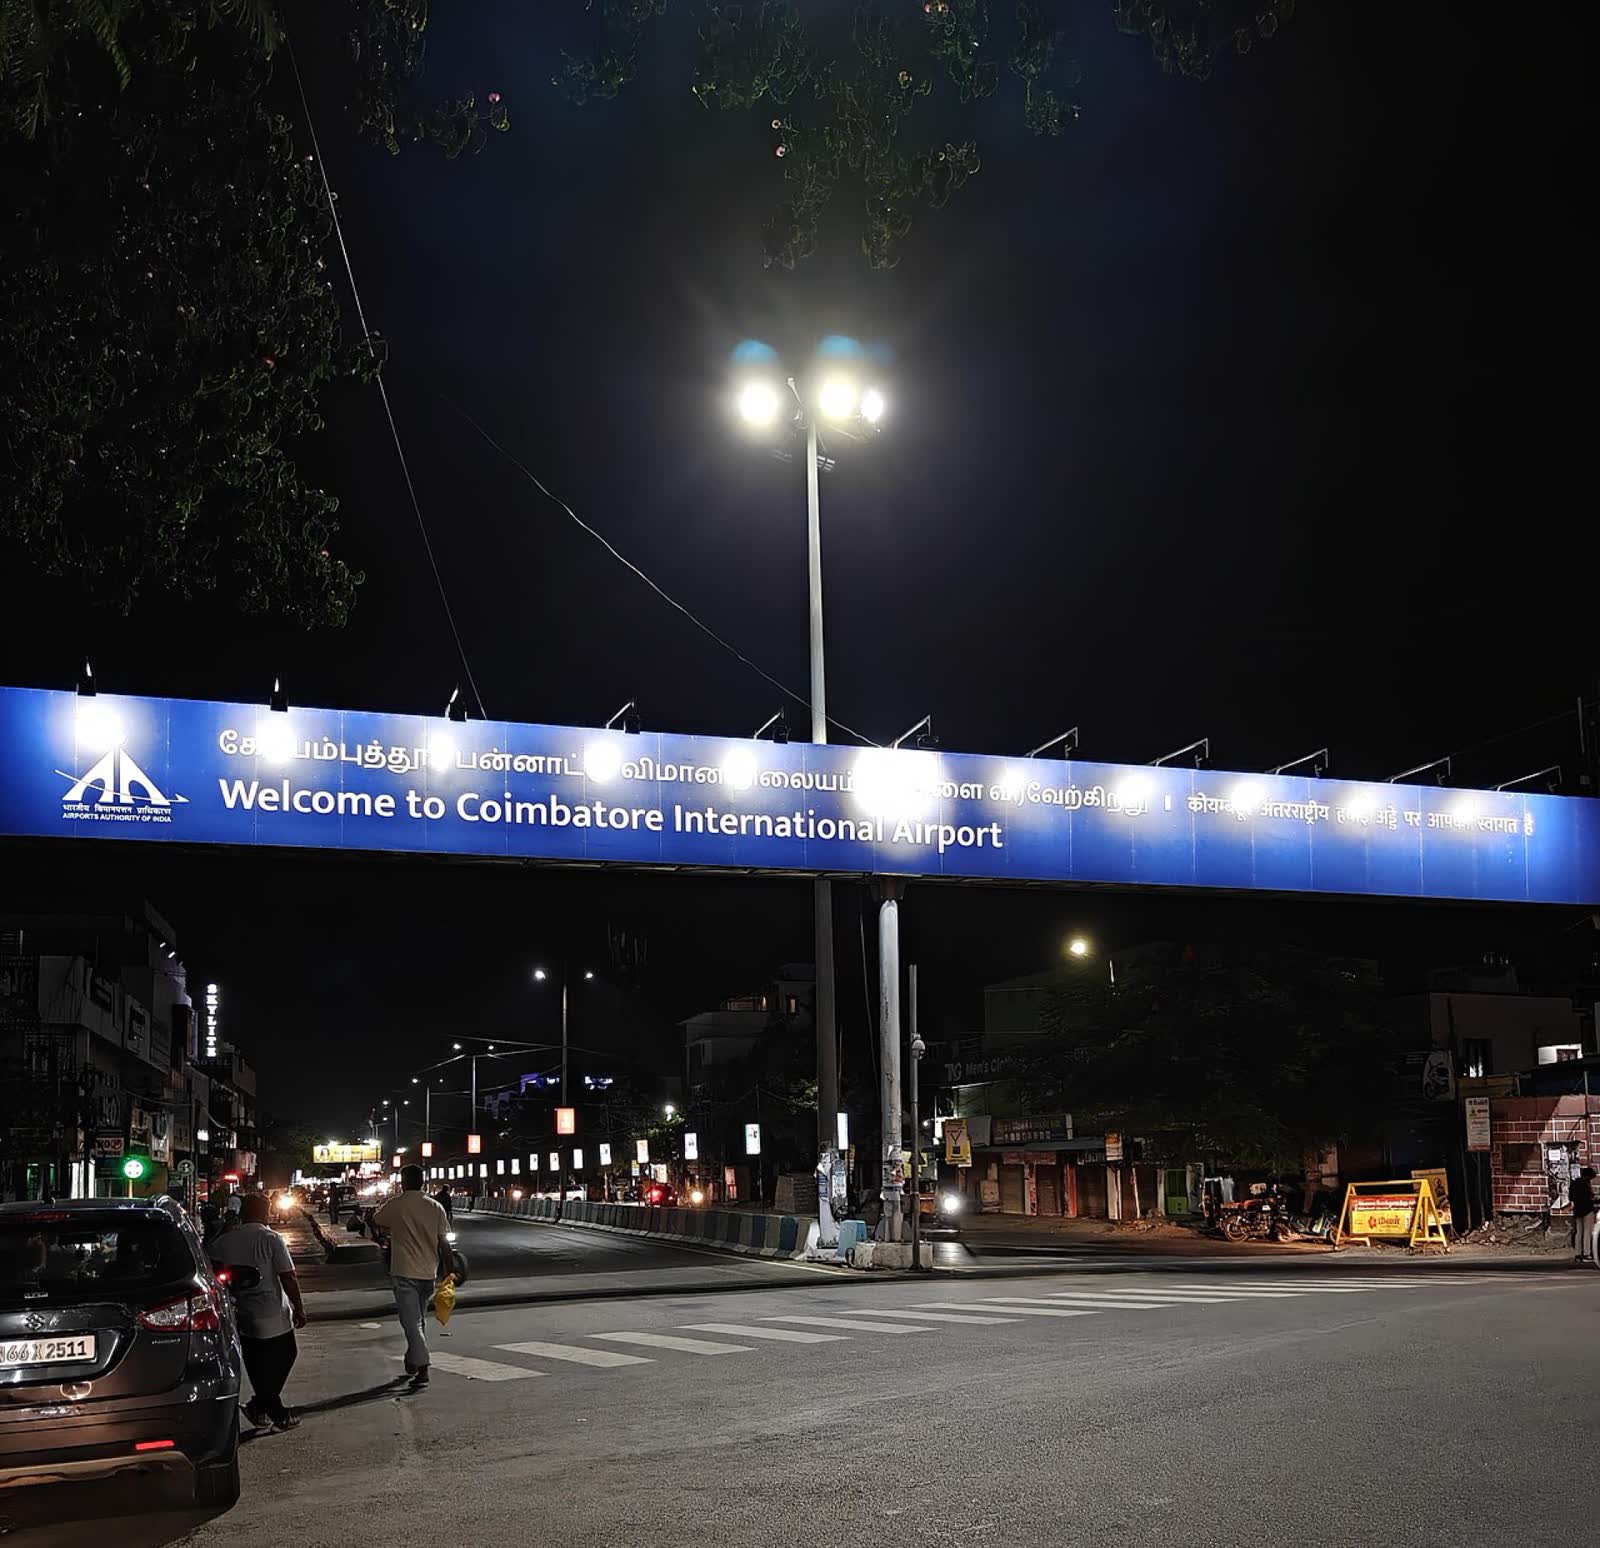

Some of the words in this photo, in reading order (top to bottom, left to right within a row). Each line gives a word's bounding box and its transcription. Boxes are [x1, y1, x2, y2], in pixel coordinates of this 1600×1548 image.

[62, 812, 99, 820] AIRPORTS
[100, 814, 140, 822] AUTHORITY
[219, 779, 396, 817] Welcome
[406, 790, 446, 819] to
[457, 791, 664, 831] Coimbatore
[674, 805, 884, 842] International
[892, 817, 1003, 853] Airport
[1404, 810, 1421, 827] पर
